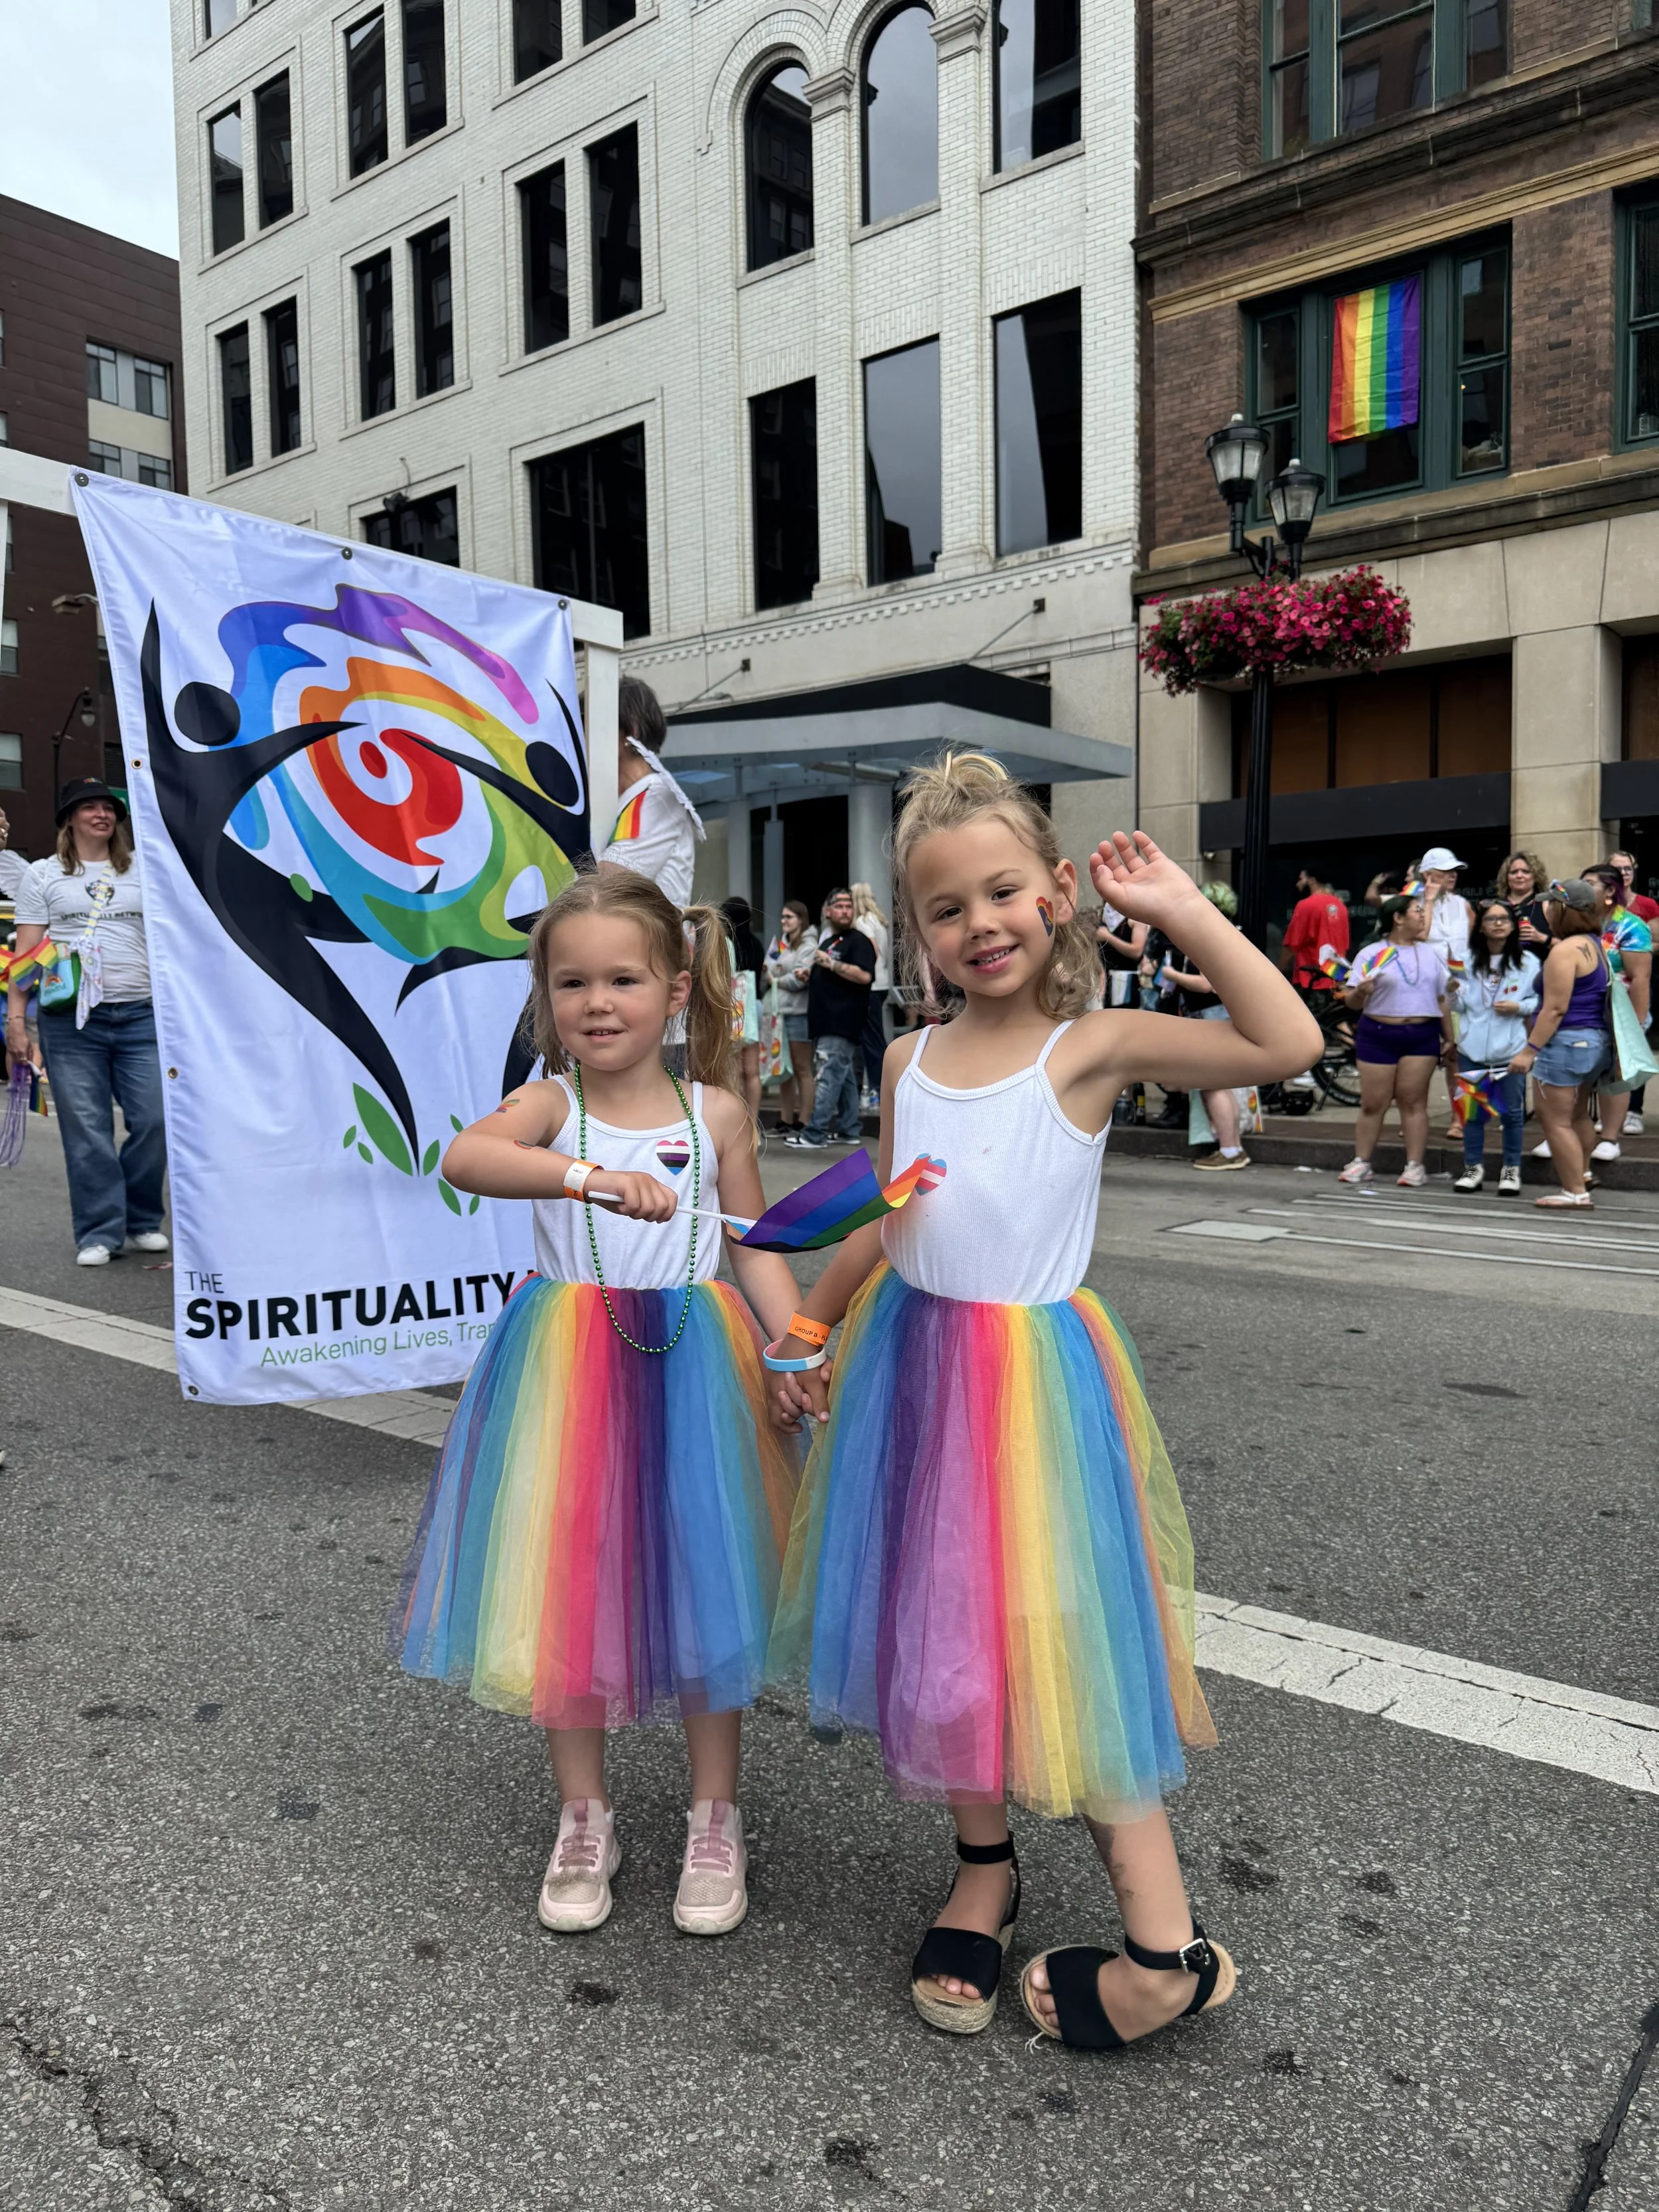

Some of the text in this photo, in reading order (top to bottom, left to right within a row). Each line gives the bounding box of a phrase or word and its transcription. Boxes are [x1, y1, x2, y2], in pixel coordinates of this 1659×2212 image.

[185, 1271, 224, 1293] THE
[185, 1270, 515, 1341] SPIRITUALITY
[260, 1334, 387, 1367] Awakening
[394, 1325, 453, 1350] Lives,
[794, 1326, 813, 1335] GROUP
